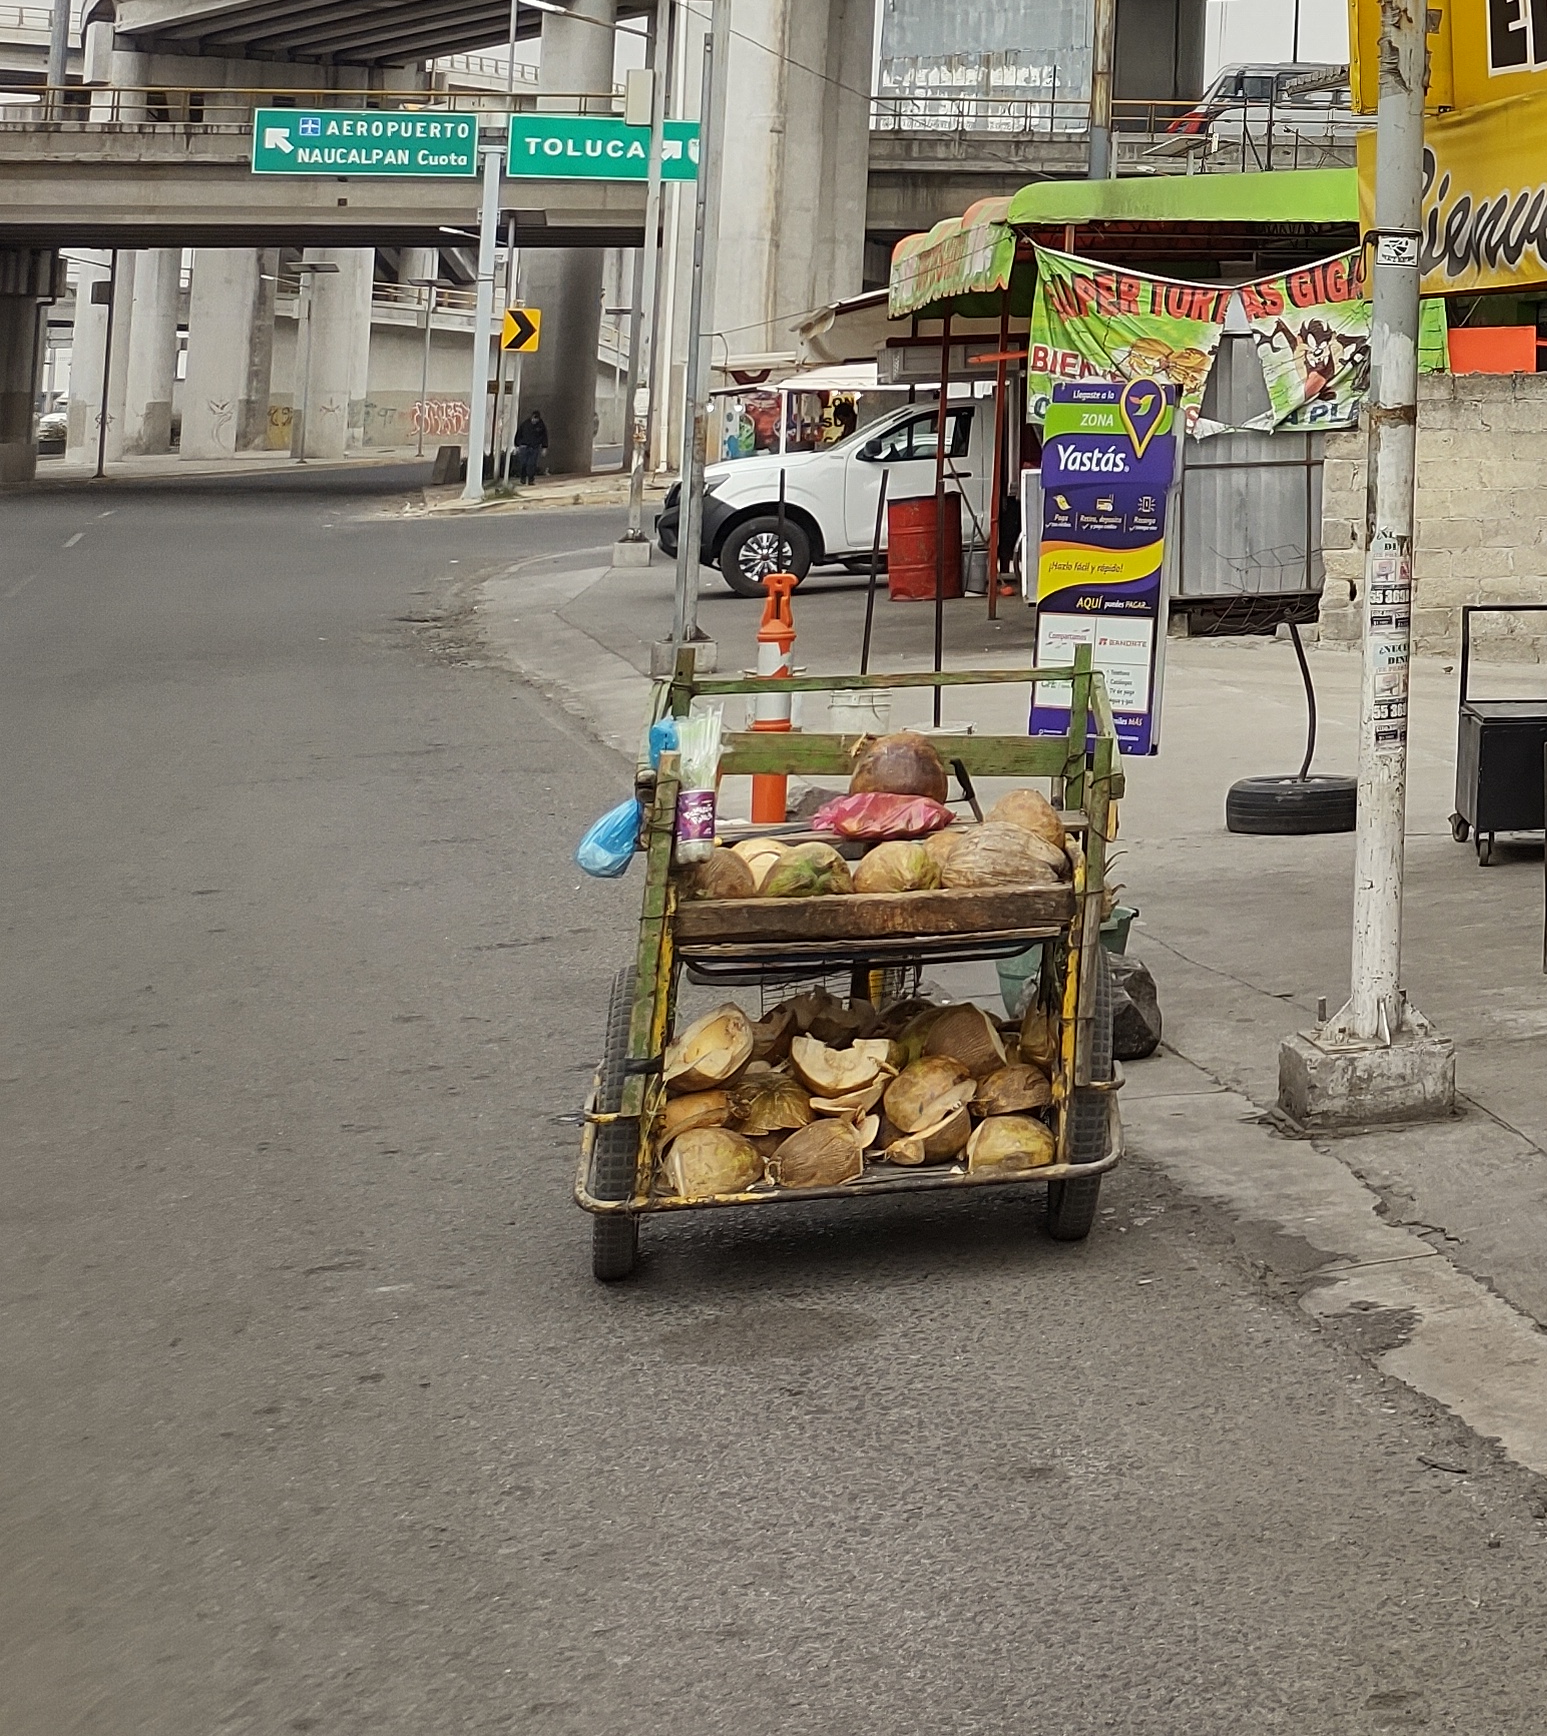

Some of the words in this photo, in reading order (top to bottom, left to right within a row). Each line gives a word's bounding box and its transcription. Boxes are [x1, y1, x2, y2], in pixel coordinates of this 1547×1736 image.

[326, 120, 470, 139] AEROPUERTO
[525, 136, 646, 159] TOLUCA
[297, 147, 410, 166] NAUCALPAN
[417, 149, 468, 166] Cuota
[1080, 414, 1114, 427] ZONA
[1076, 595, 1103, 609] AQUÍ
[1109, 639, 1147, 648] BANORTE
